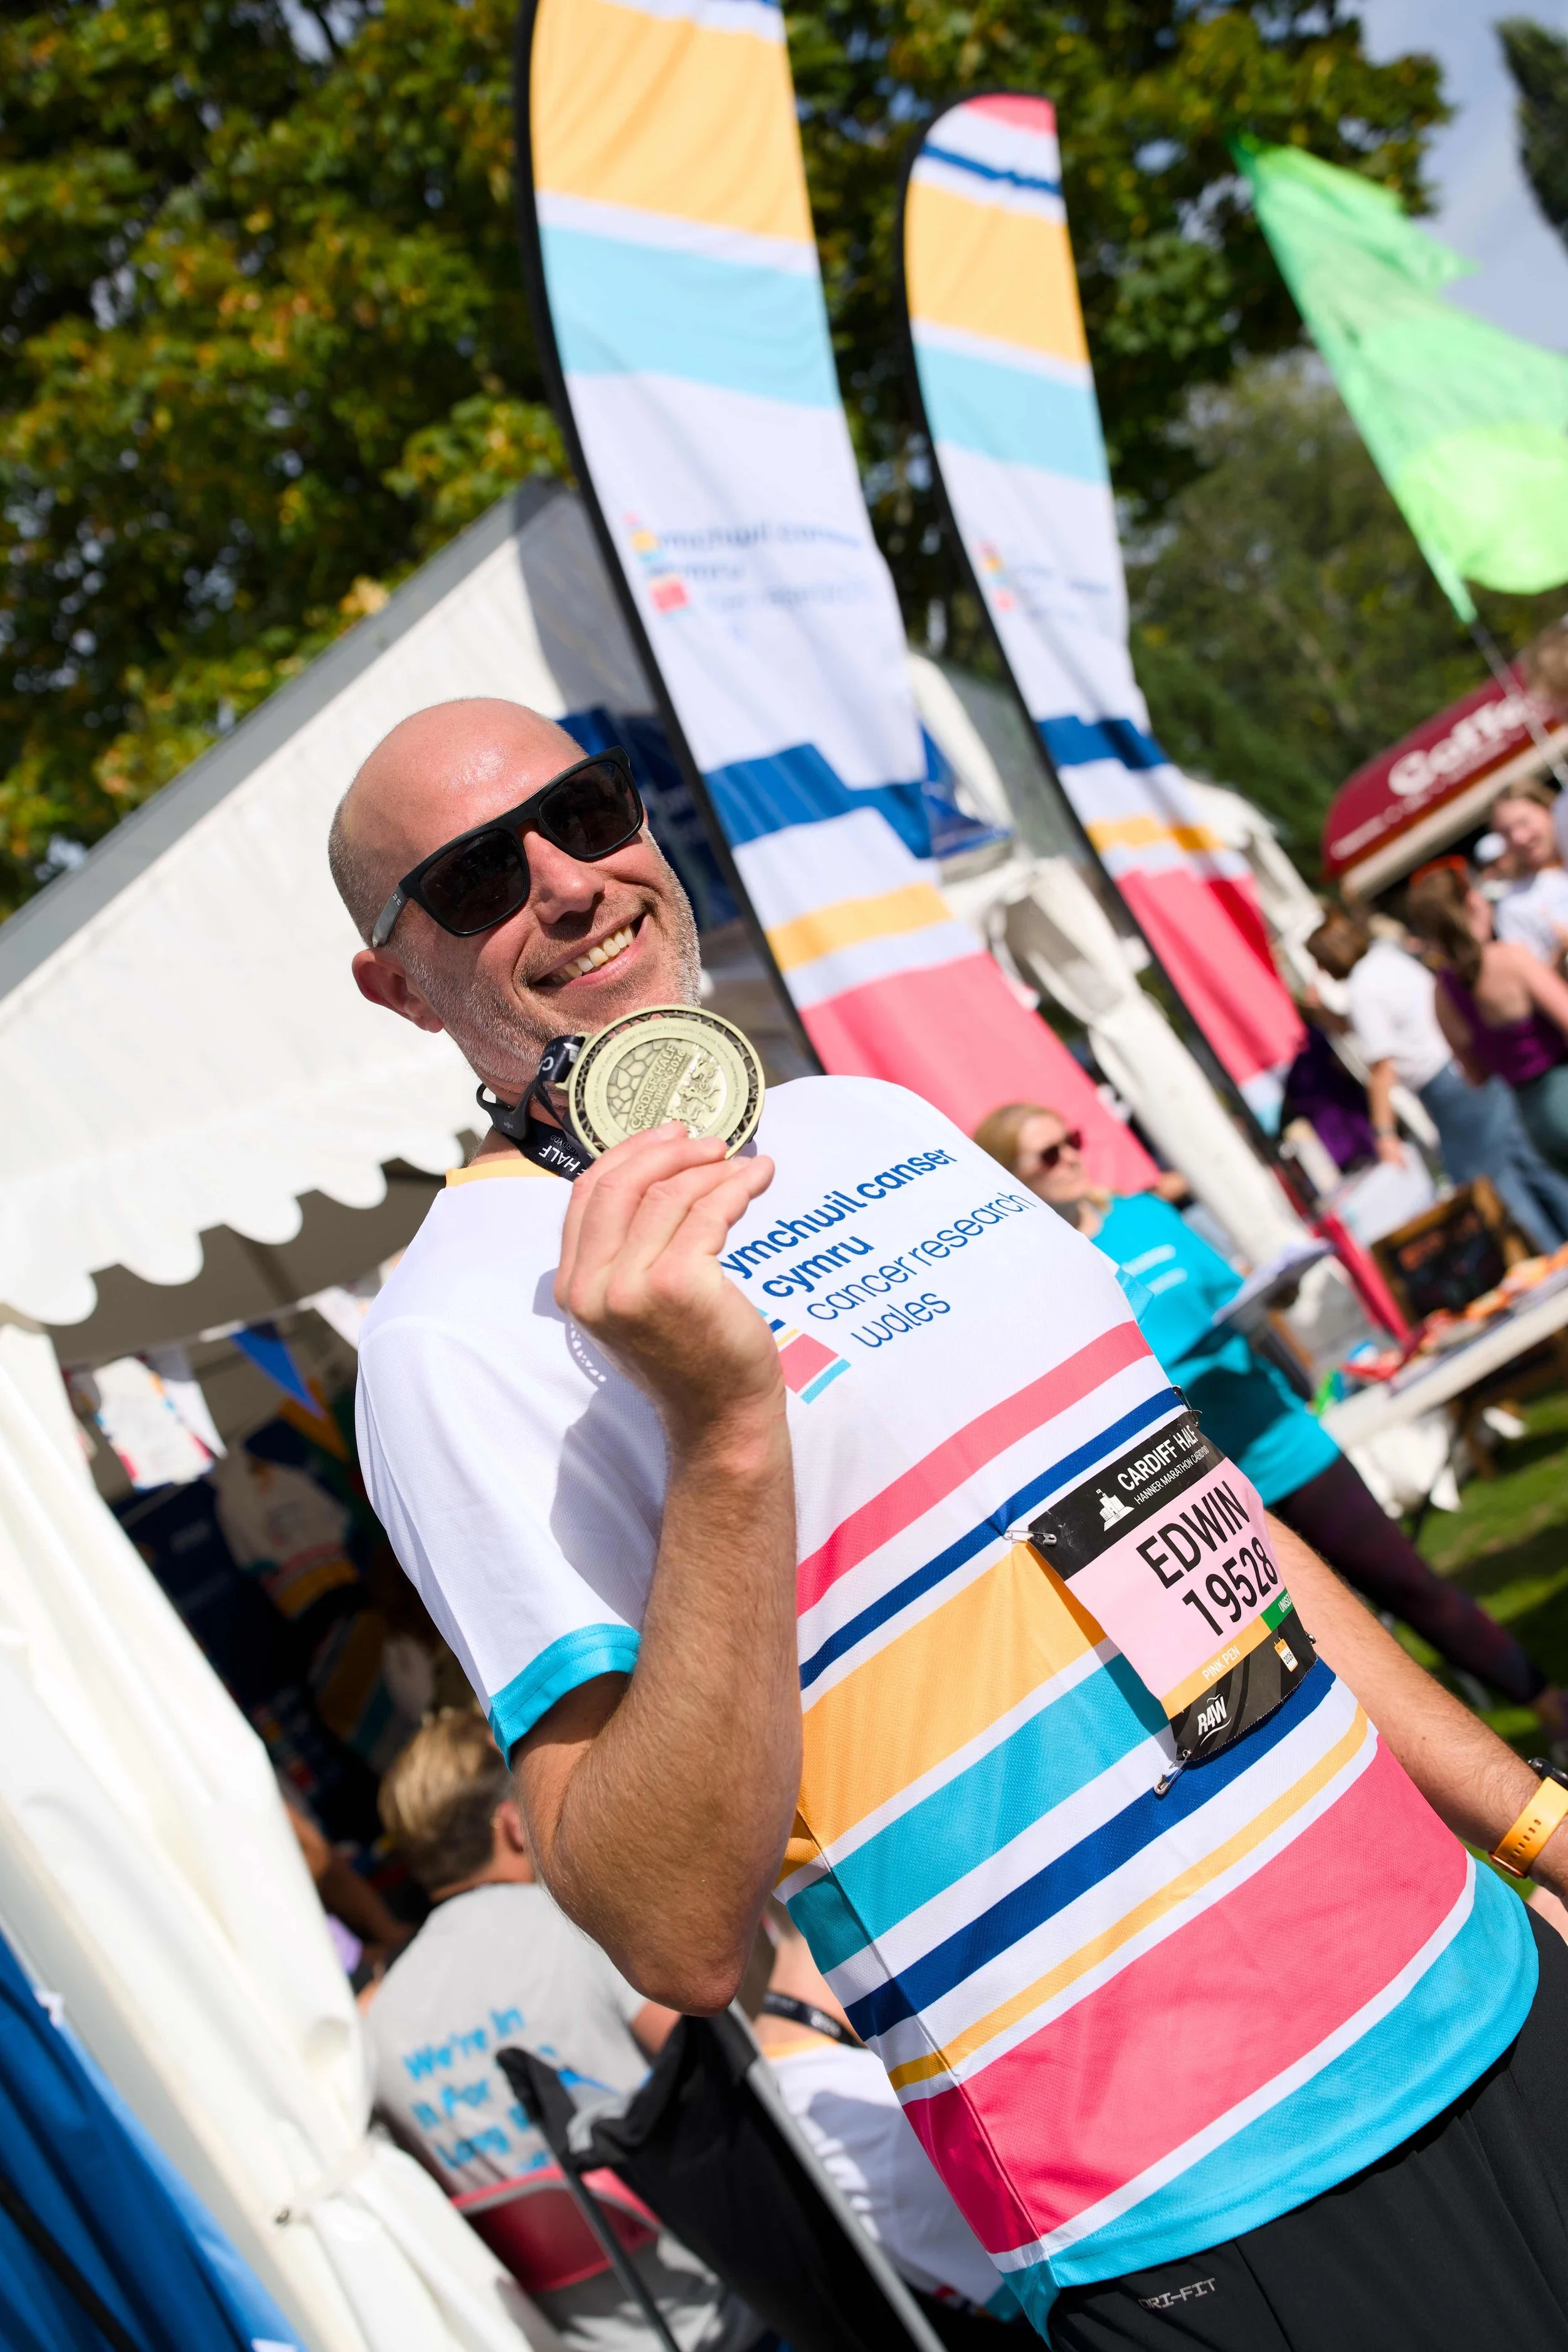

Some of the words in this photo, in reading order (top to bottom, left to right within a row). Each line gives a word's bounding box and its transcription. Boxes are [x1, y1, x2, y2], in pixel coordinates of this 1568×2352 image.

[630, 1078, 656, 1129] CARDIFF
[654, 1045, 675, 1076] HALF
[642, 1073, 671, 1129] MARATHON
[667, 1049, 686, 1073] 2026
[539, 1145, 581, 1172] HALF
[720, 1190, 868, 1279] ymchwil
[857, 1149, 957, 1199] canser
[762, 1236, 875, 1298] cymru
[807, 1256, 917, 1320] cancer
[908, 1192, 1037, 1266] research
[850, 1292, 951, 1348] wales
[1117, 1439, 1178, 1491] CARDIFF
[1172, 1424, 1199, 1452] HALF
[1133, 1480, 1164, 1505] HANNER
[1160, 1457, 1194, 1486] MARATHON
[1136, 1480, 1250, 1589] EDWIN
[1182, 1537, 1278, 1636] 19528
[1202, 1658, 1225, 1682] PINK
[1222, 1645, 1241, 1666] PEN
[1283, 1651, 1294, 1665] 2026
[1197, 1696, 1227, 1736] R4W
[1138, 2277, 1216, 2309] DRI-FIT
